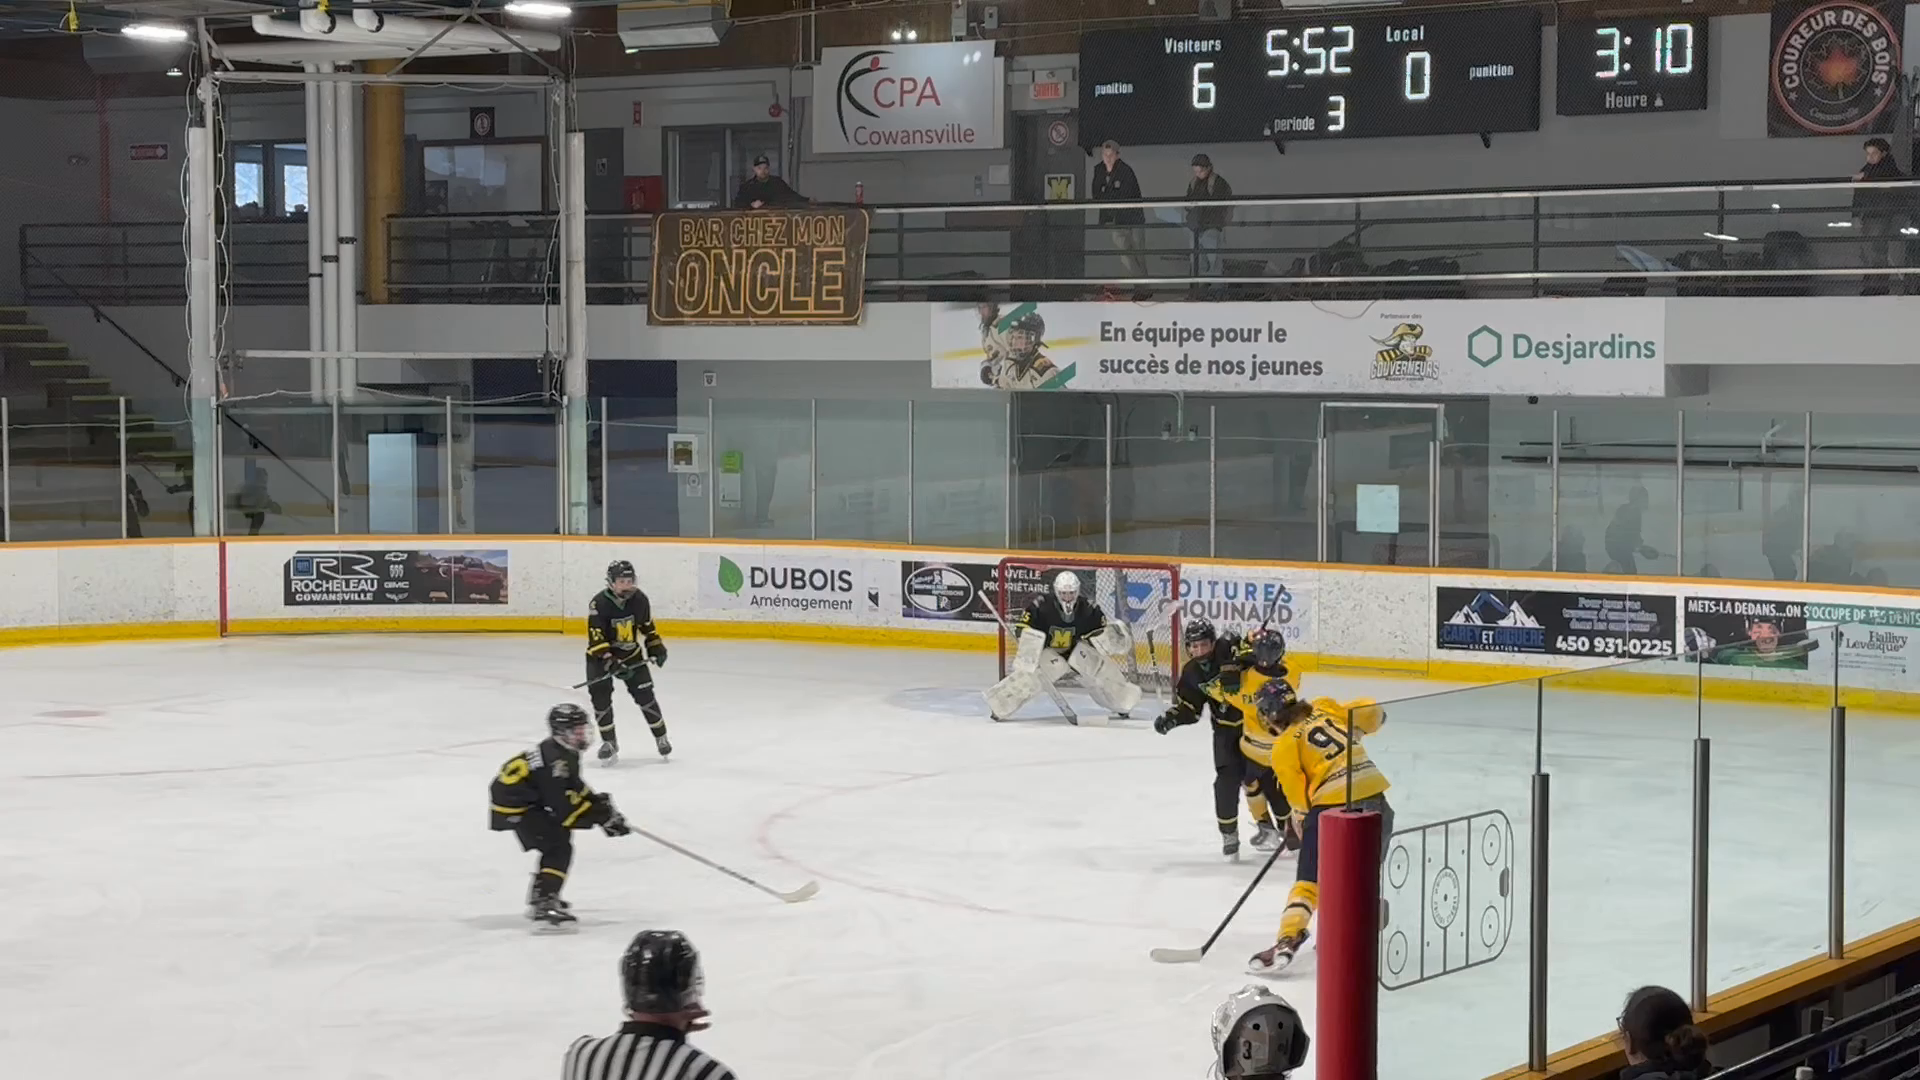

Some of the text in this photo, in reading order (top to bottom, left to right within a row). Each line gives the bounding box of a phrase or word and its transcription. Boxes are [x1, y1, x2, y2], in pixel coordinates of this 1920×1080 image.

[1386, 25, 1425, 42] Local
[1164, 37, 1222, 54] Visiteurs
[1266, 25, 1355, 76] 5:52
[1782, 9, 1891, 89] COUREUR DES BOIS
[1405, 51, 1431, 100] 0
[1469, 63, 1514, 80] punition
[873, 75, 941, 109] CPA
[1094, 82, 1134, 98] punition
[1192, 61, 1216, 109] 6
[1605, 91, 1648, 109] Heure
[1327, 95, 1346, 132] 3
[853, 123, 975, 146] Cowansville
[679, 215, 845, 248] BAR CHEZ MON
[675, 247, 846, 315] ONCLE
[1100, 321, 1288, 348] En équipe pour le
[1512, 333, 1656, 365] Desjardins
[1099, 353, 1324, 381] succès de nos jeunes
[750, 566, 853, 592] DUBOIS
[991, 568, 1041, 580] NUVELLE
[291, 579, 378, 593] ROCHELEAU
[295, 592, 375, 601] COWANSVILLE
[750, 594, 853, 612] Aménagement
[1804, 606, 1850, 620] S'OCCUPE
[1482, 630, 1494, 644] ET
[1556, 635, 1673, 655] 450 931-0225
[1469, 643, 1519, 652] EXCAVATION
[1242, 1040, 1252, 1060] 3
